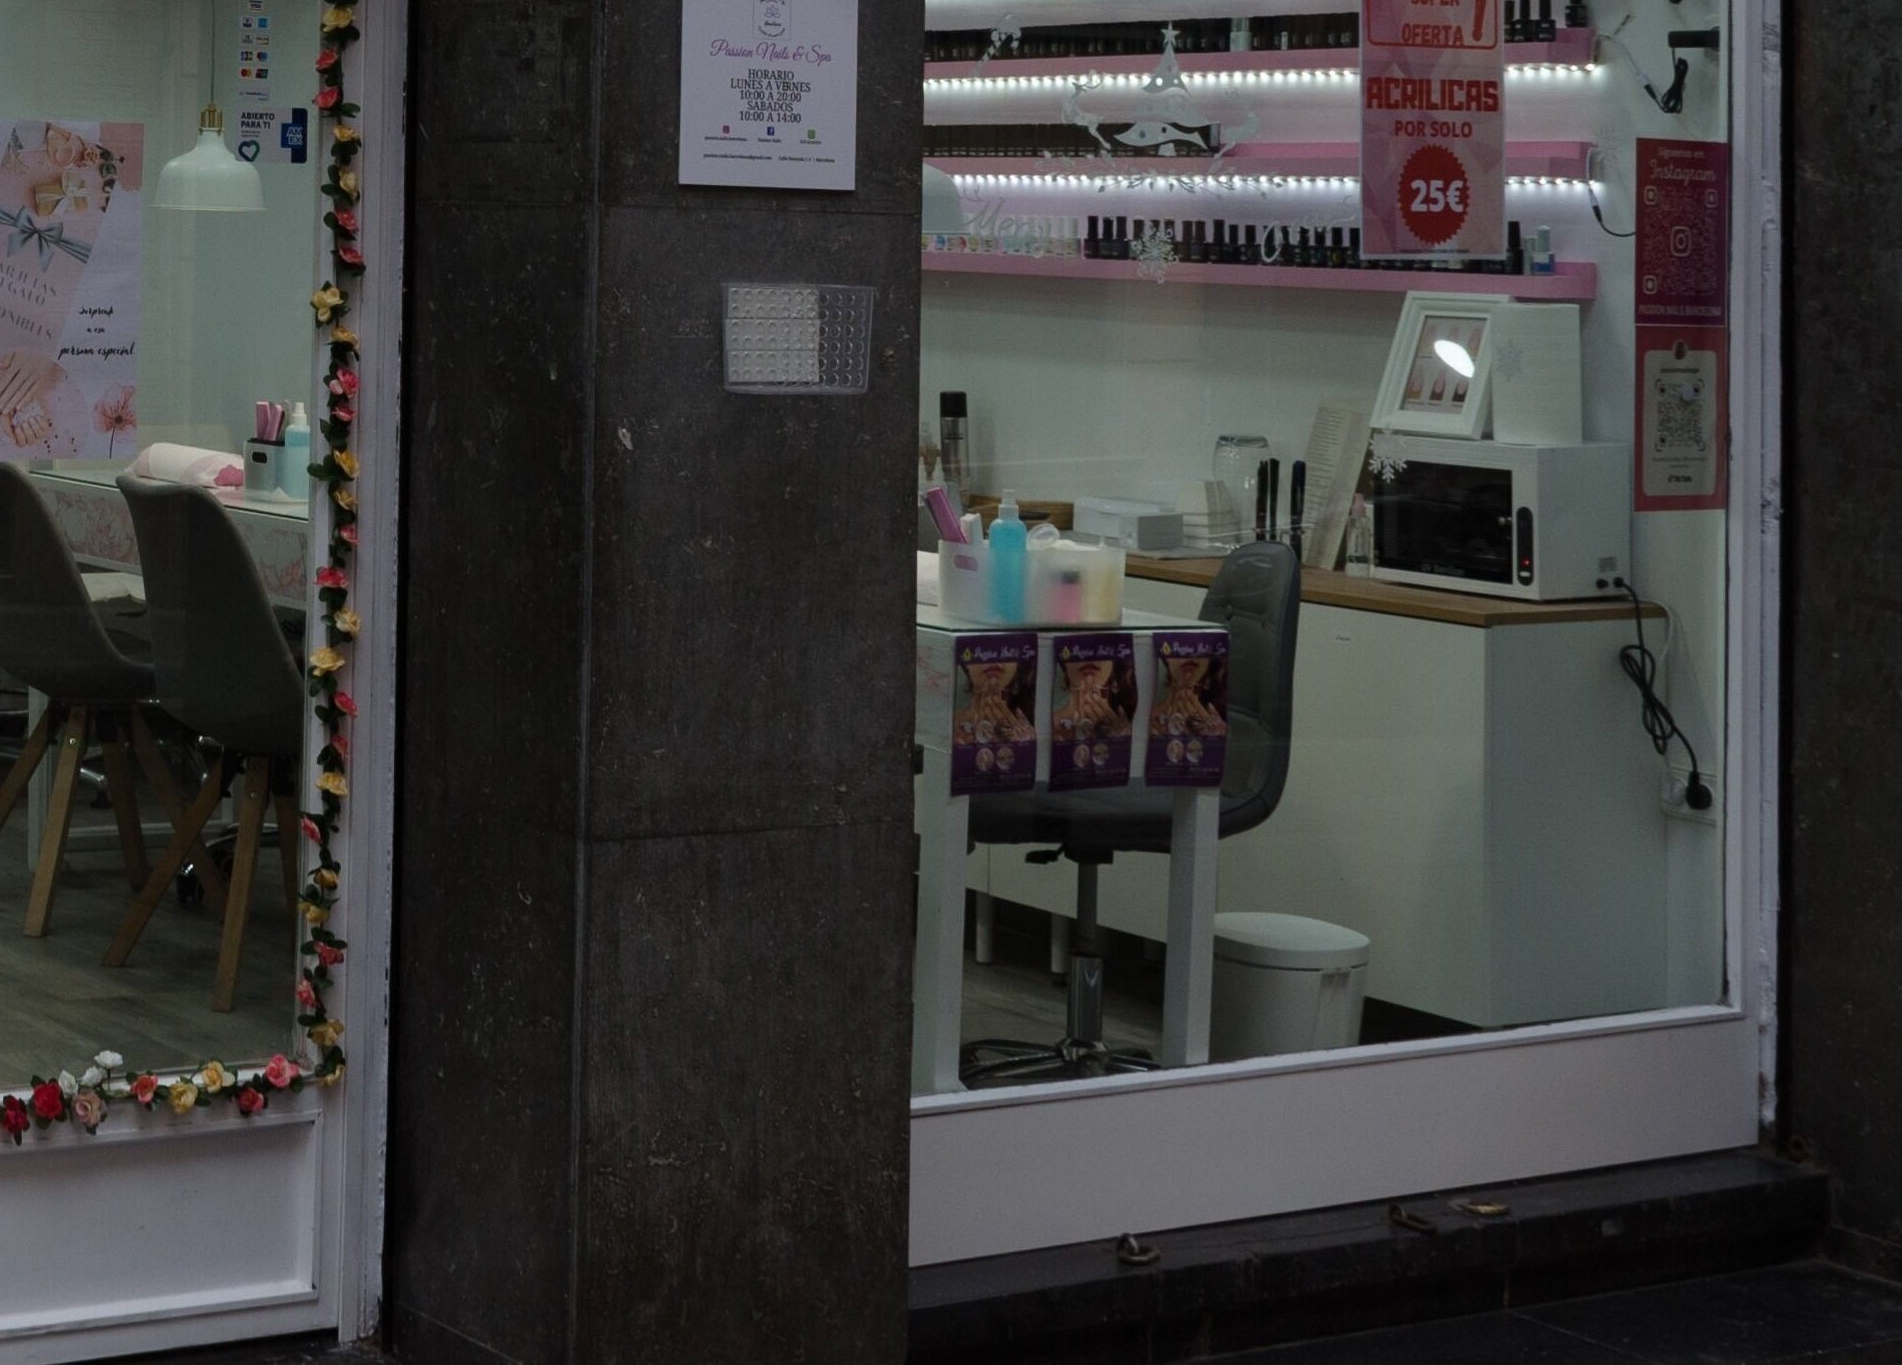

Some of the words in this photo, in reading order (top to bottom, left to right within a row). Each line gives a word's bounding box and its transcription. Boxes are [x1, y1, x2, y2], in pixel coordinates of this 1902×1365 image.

[1401, 22, 1464, 47] OFERTA
[709, 38, 754, 60] Passion
[755, 40, 790, 63] Nails
[792, 46, 805, 62] &
[805, 43, 833, 67] Spa
[748, 68, 795, 81] HORARIO
[731, 78, 764, 90] LUNES
[766, 80, 774, 91] A
[740, 89, 765, 101] 10:00
[767, 90, 774, 101] A
[776, 91, 802, 103] 20:00
[1365, 76, 1499, 113] ACRILICAS
[240, 111, 275, 121] ABIERTO
[740, 110, 765, 122] 10:00
[767, 112, 774, 123] A
[777, 112, 802, 124] 14:00
[240, 120, 261, 129] PARA
[1394, 120, 1426, 138] POR
[1429, 121, 1473, 139] SOLO
[1648, 158, 1717, 187] Instagram
[1409, 178, 1465, 214] 25€
